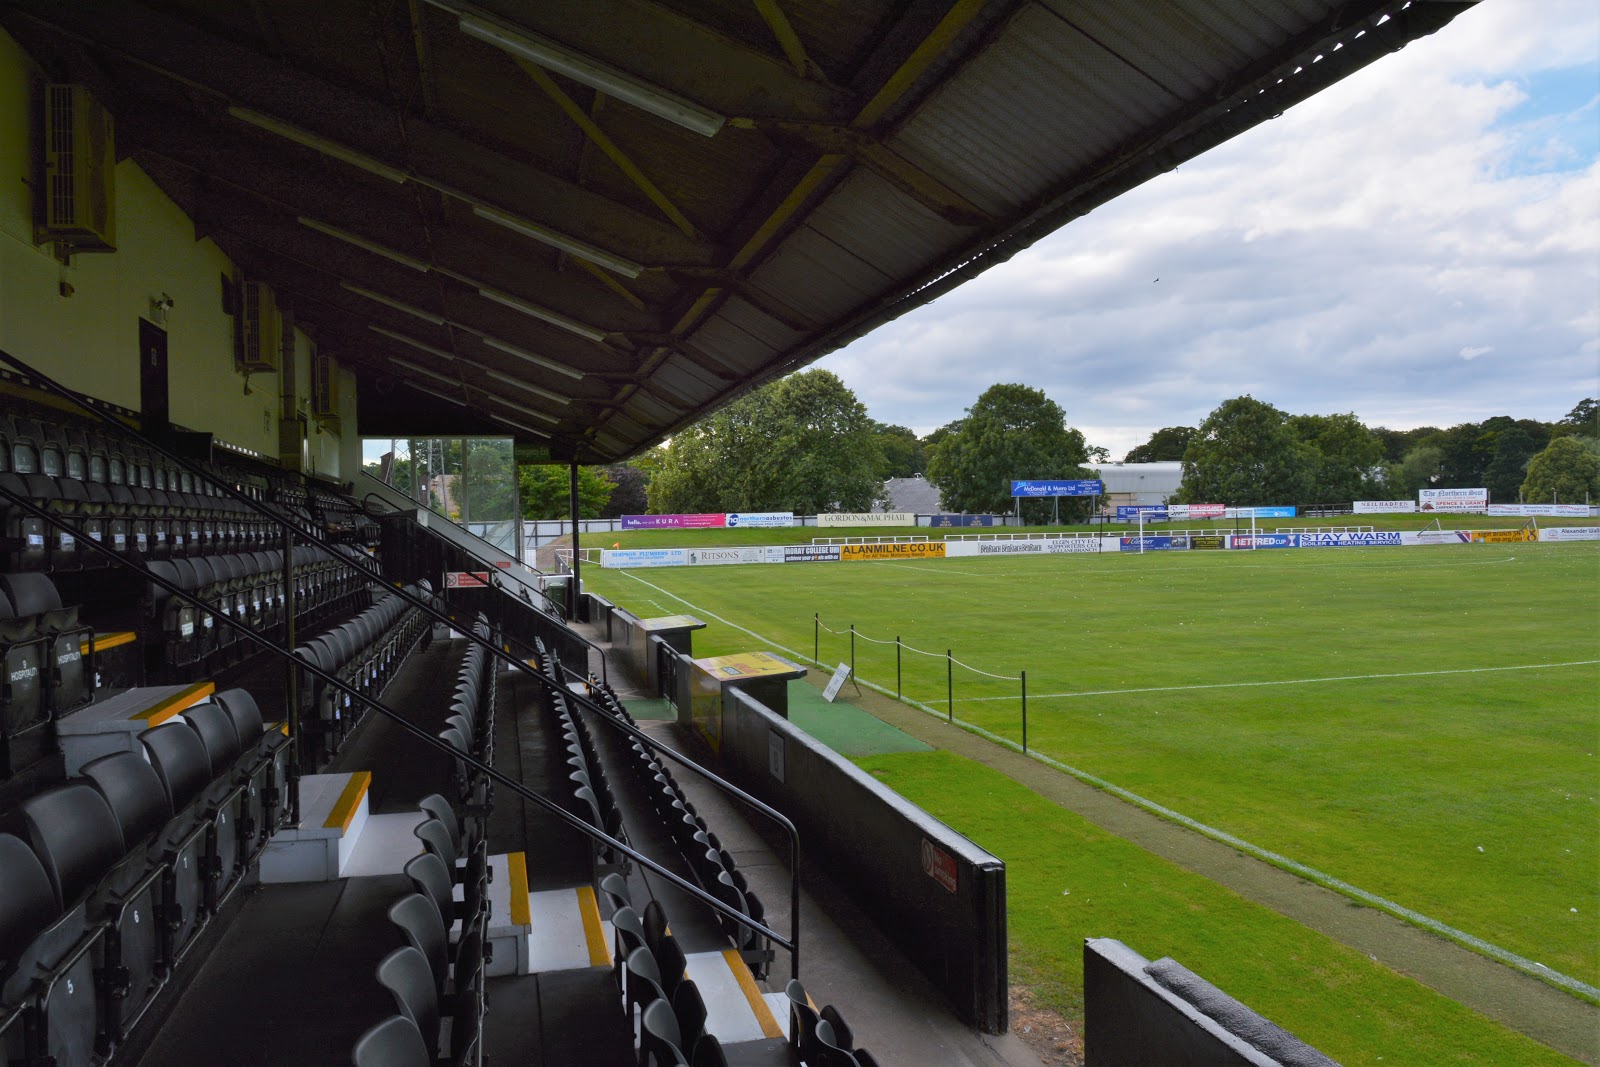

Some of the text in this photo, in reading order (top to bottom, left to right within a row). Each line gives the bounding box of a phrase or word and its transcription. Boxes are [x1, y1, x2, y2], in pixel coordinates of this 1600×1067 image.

[1234, 537, 1276, 546] BETFRED
[1302, 533, 1342, 541] STAY
[1349, 532, 1400, 540] WARM
[843, 542, 944, 555] ALANMILNE.CO.UK
[701, 551, 739, 560] RITSONS
[11, 667, 39, 682] HOSPITALITY
[133, 910, 139, 924] 6
[67, 979, 74, 994] 5
